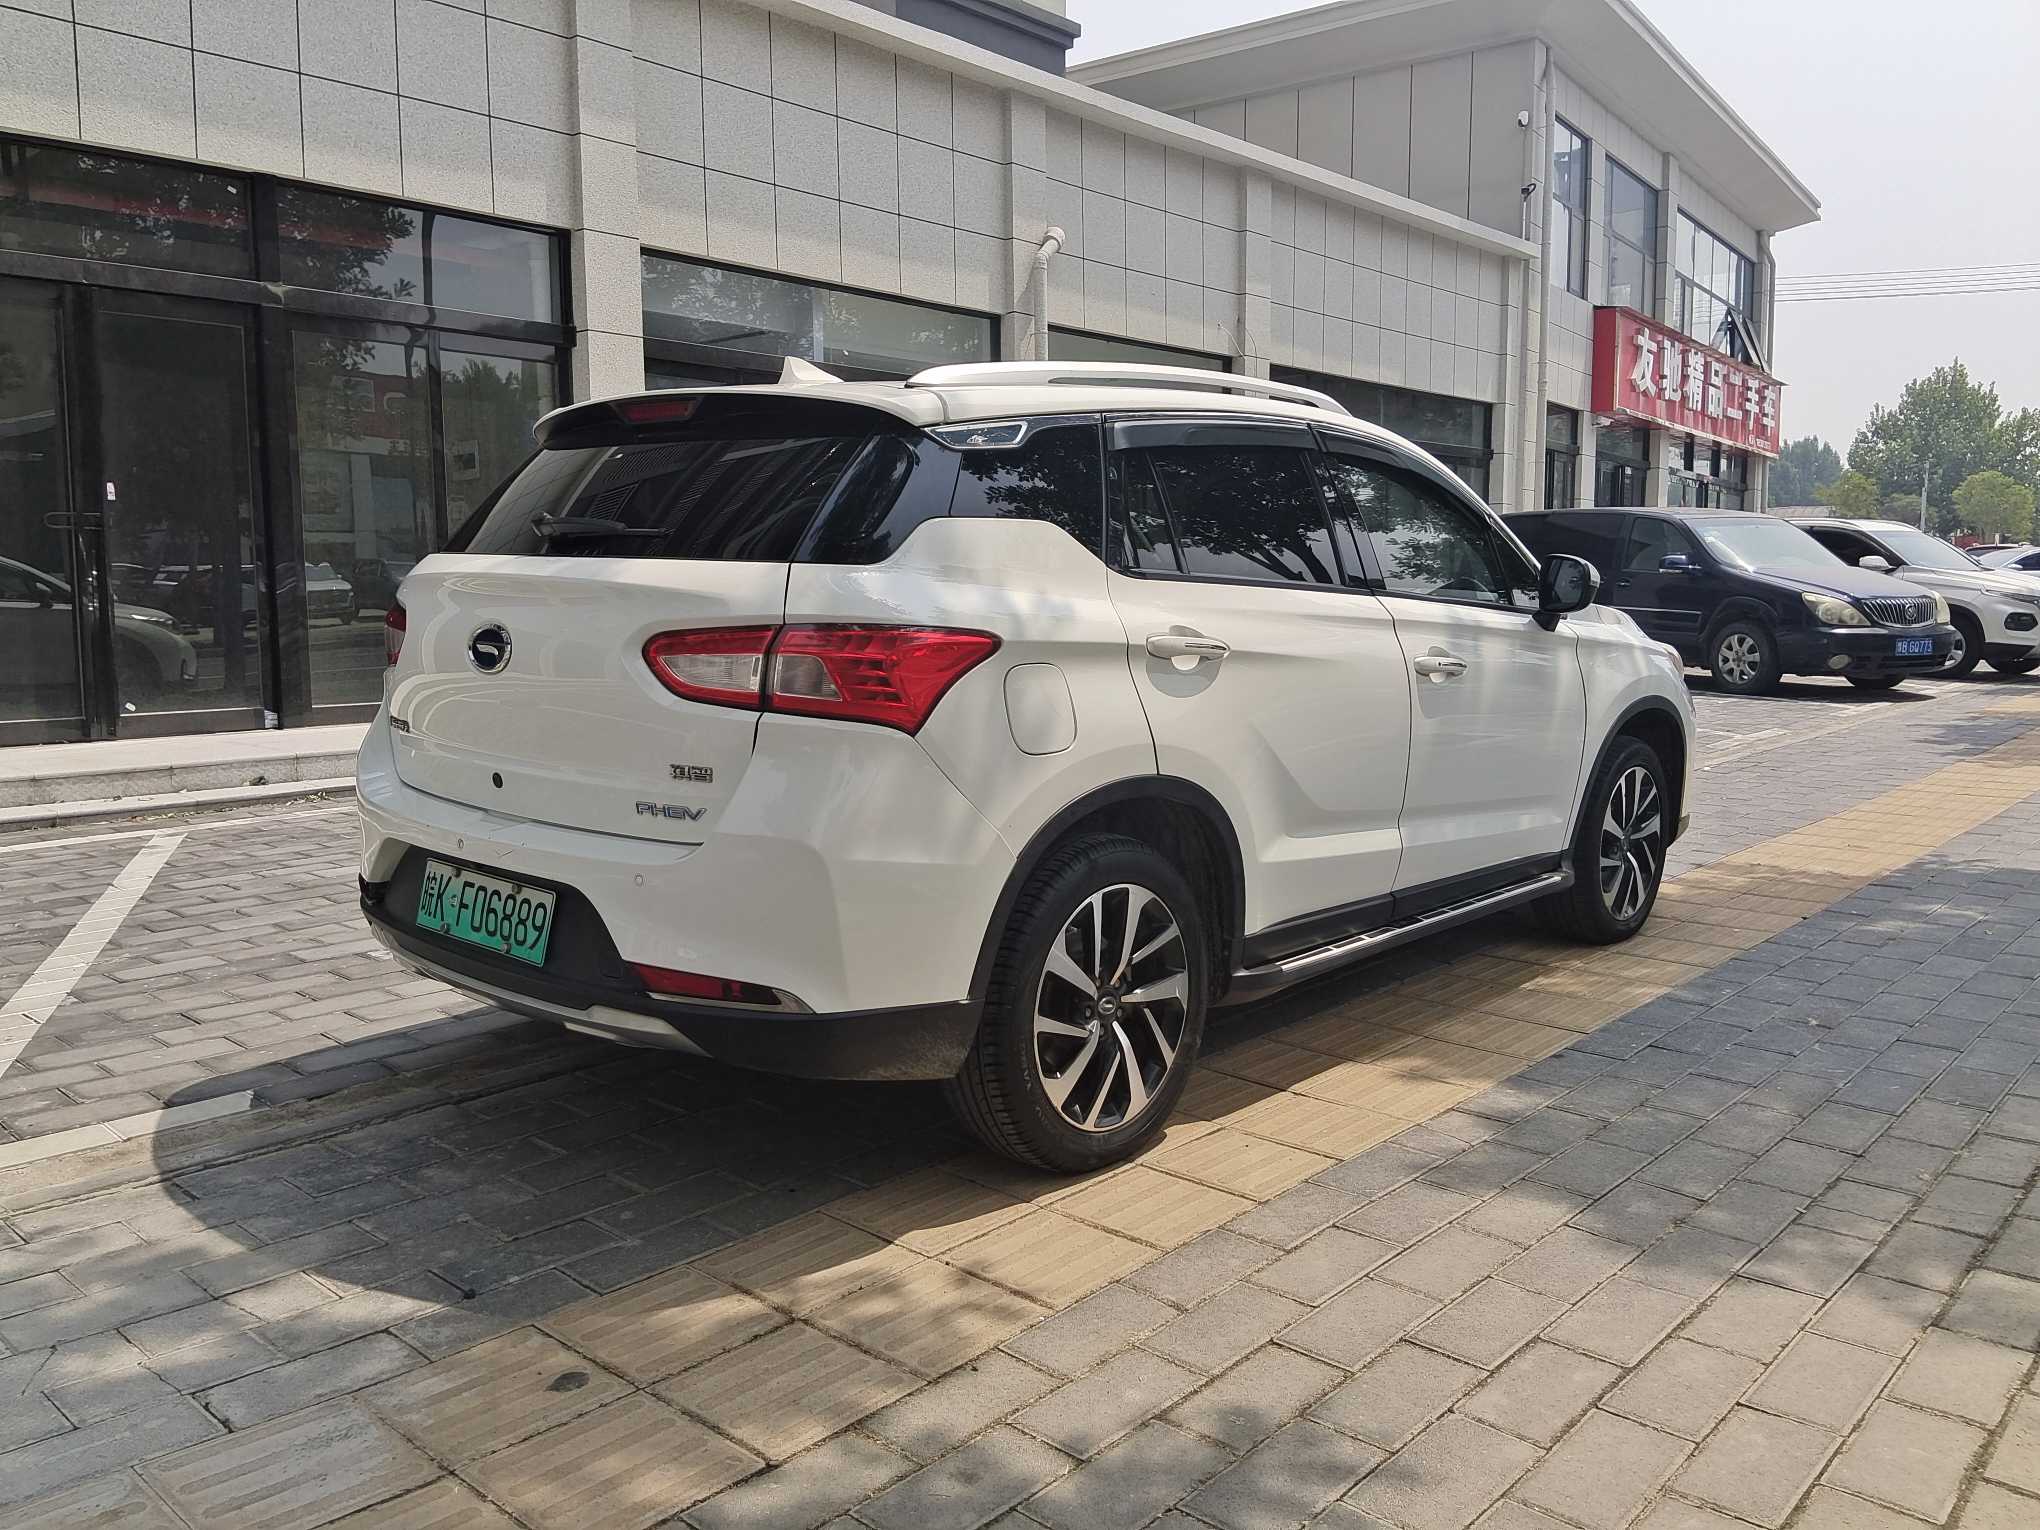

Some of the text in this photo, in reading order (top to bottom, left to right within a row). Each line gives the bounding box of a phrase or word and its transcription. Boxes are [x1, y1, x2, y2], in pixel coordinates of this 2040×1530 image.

[1631, 328, 1775, 434] 友驰精品二手车
[636, 801, 707, 821] PHEV
